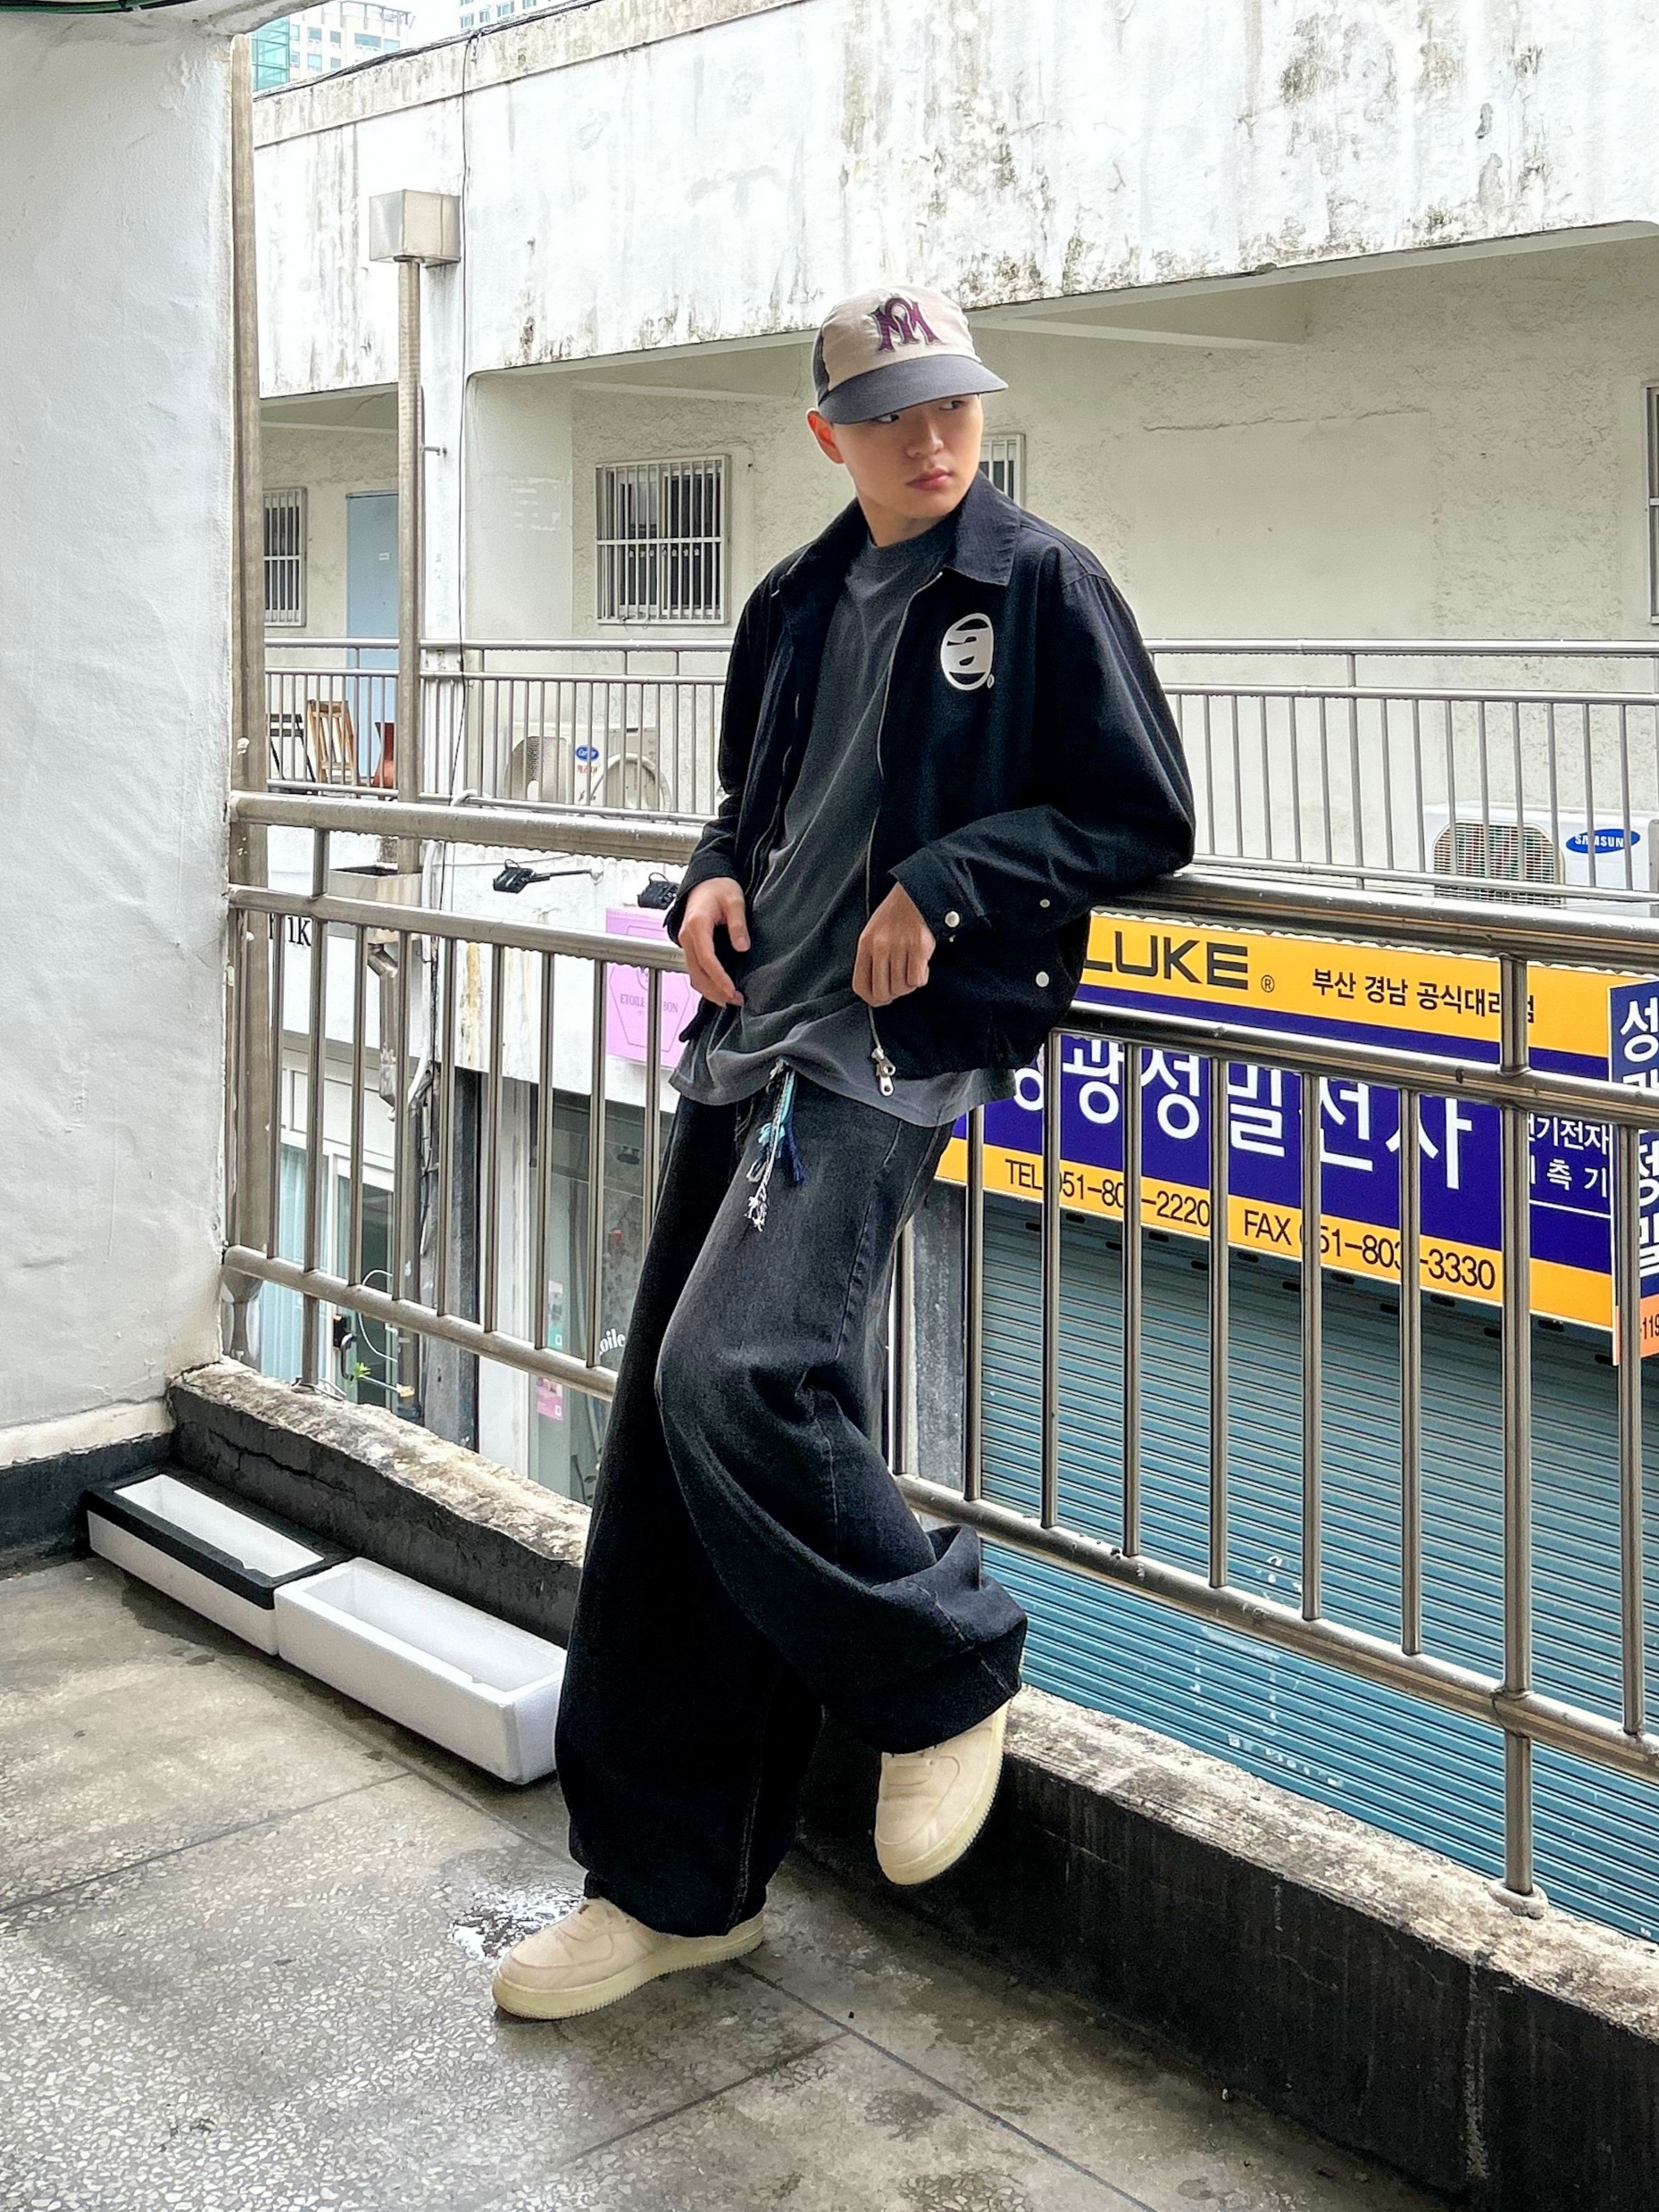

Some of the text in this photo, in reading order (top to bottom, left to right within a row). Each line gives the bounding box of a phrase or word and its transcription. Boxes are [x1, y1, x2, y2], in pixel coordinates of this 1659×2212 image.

[1574, 834, 1624, 847] SASUN
[1313, 968, 1356, 999] 부산
[1364, 975, 1408, 1006] 경남
[1005, 1158, 1211, 1228] TEL 51-80-2220
[1244, 1209, 1292, 1247] FAX
